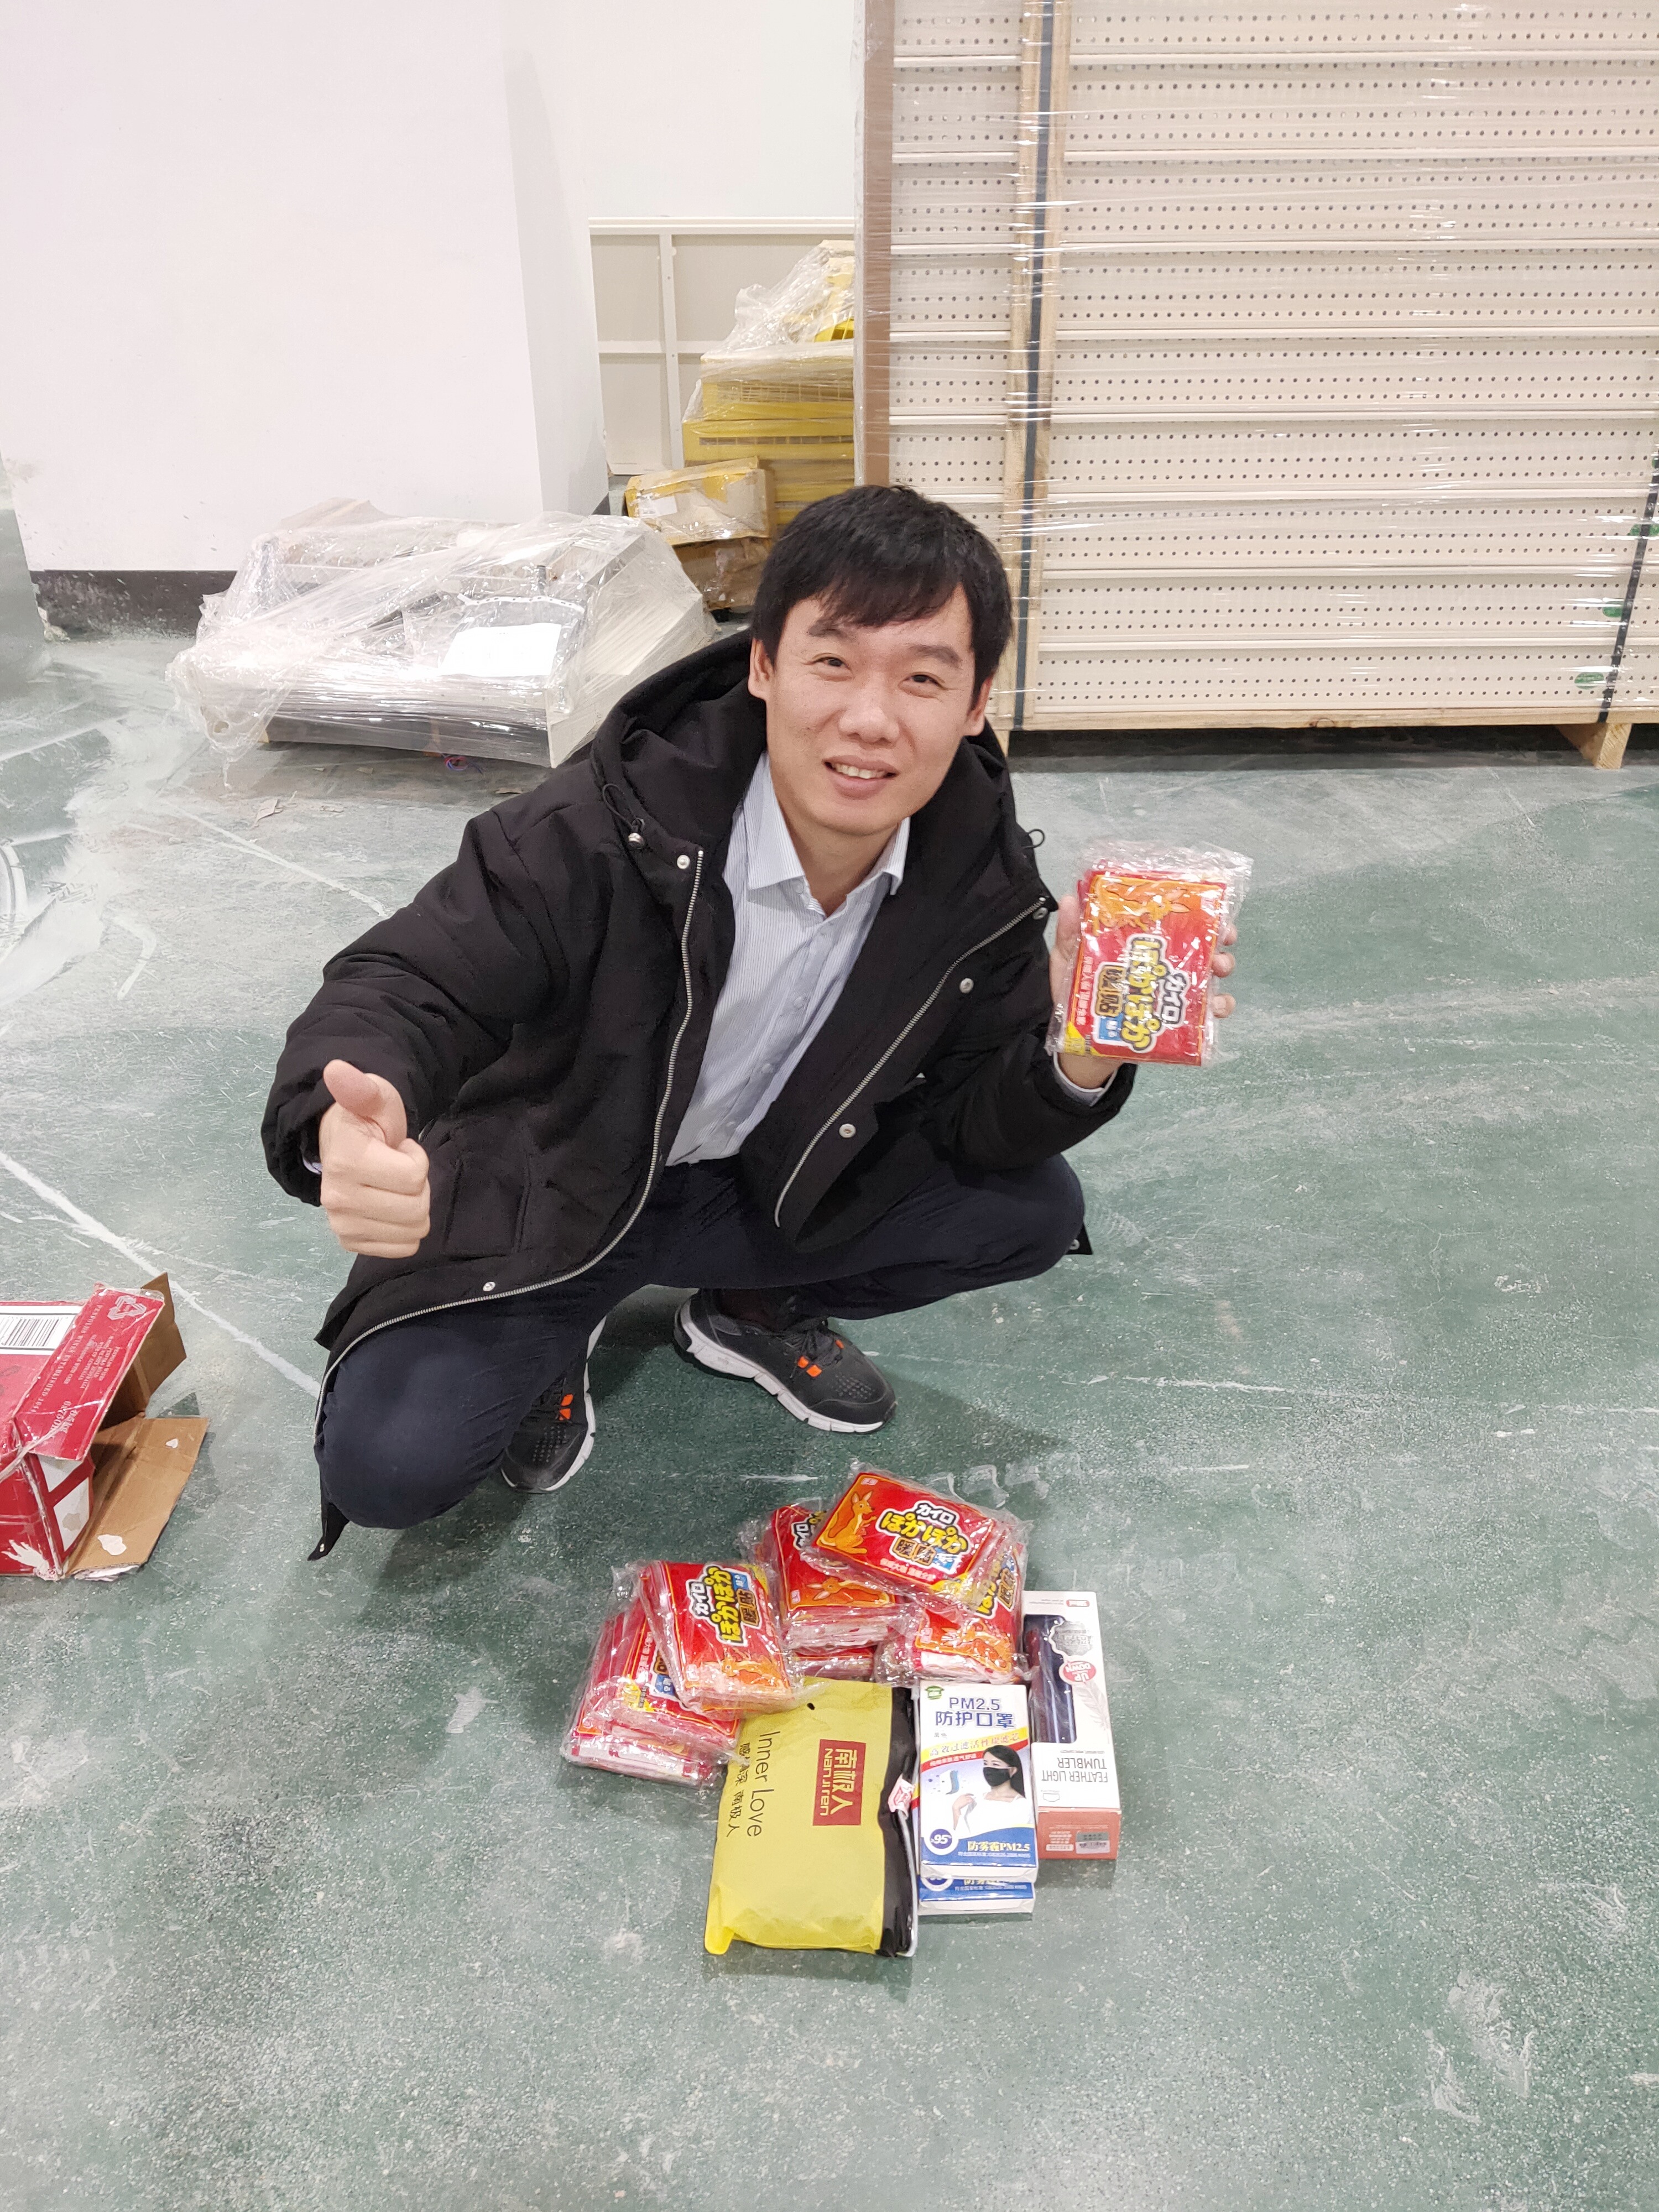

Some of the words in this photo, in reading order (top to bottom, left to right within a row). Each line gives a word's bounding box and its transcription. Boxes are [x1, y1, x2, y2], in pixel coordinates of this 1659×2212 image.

[917, 1505, 953, 1524] カイロ
[881, 1512, 967, 1552] ぽかぽか
[691, 1582, 708, 1615] カイロ
[708, 1567, 741, 1641] ぽかぽか
[1065, 1663, 1091, 1672] DOWN
[1073, 1672, 1089, 1683] UP
[948, 1697, 1000, 1711] PM2.5
[935, 1710, 1015, 1729] 防护口罩
[755, 1730, 781, 1782] Inner
[1057, 1756, 1107, 1770] TUMBLER
[830, 1748, 858, 1814] 南极人
[1042, 1770, 1067, 1782] LIGHT
[1070, 1771, 1108, 1783] FEATHER
[727, 1790, 744, 1838] 南极人
[747, 1789, 774, 1838] Love
